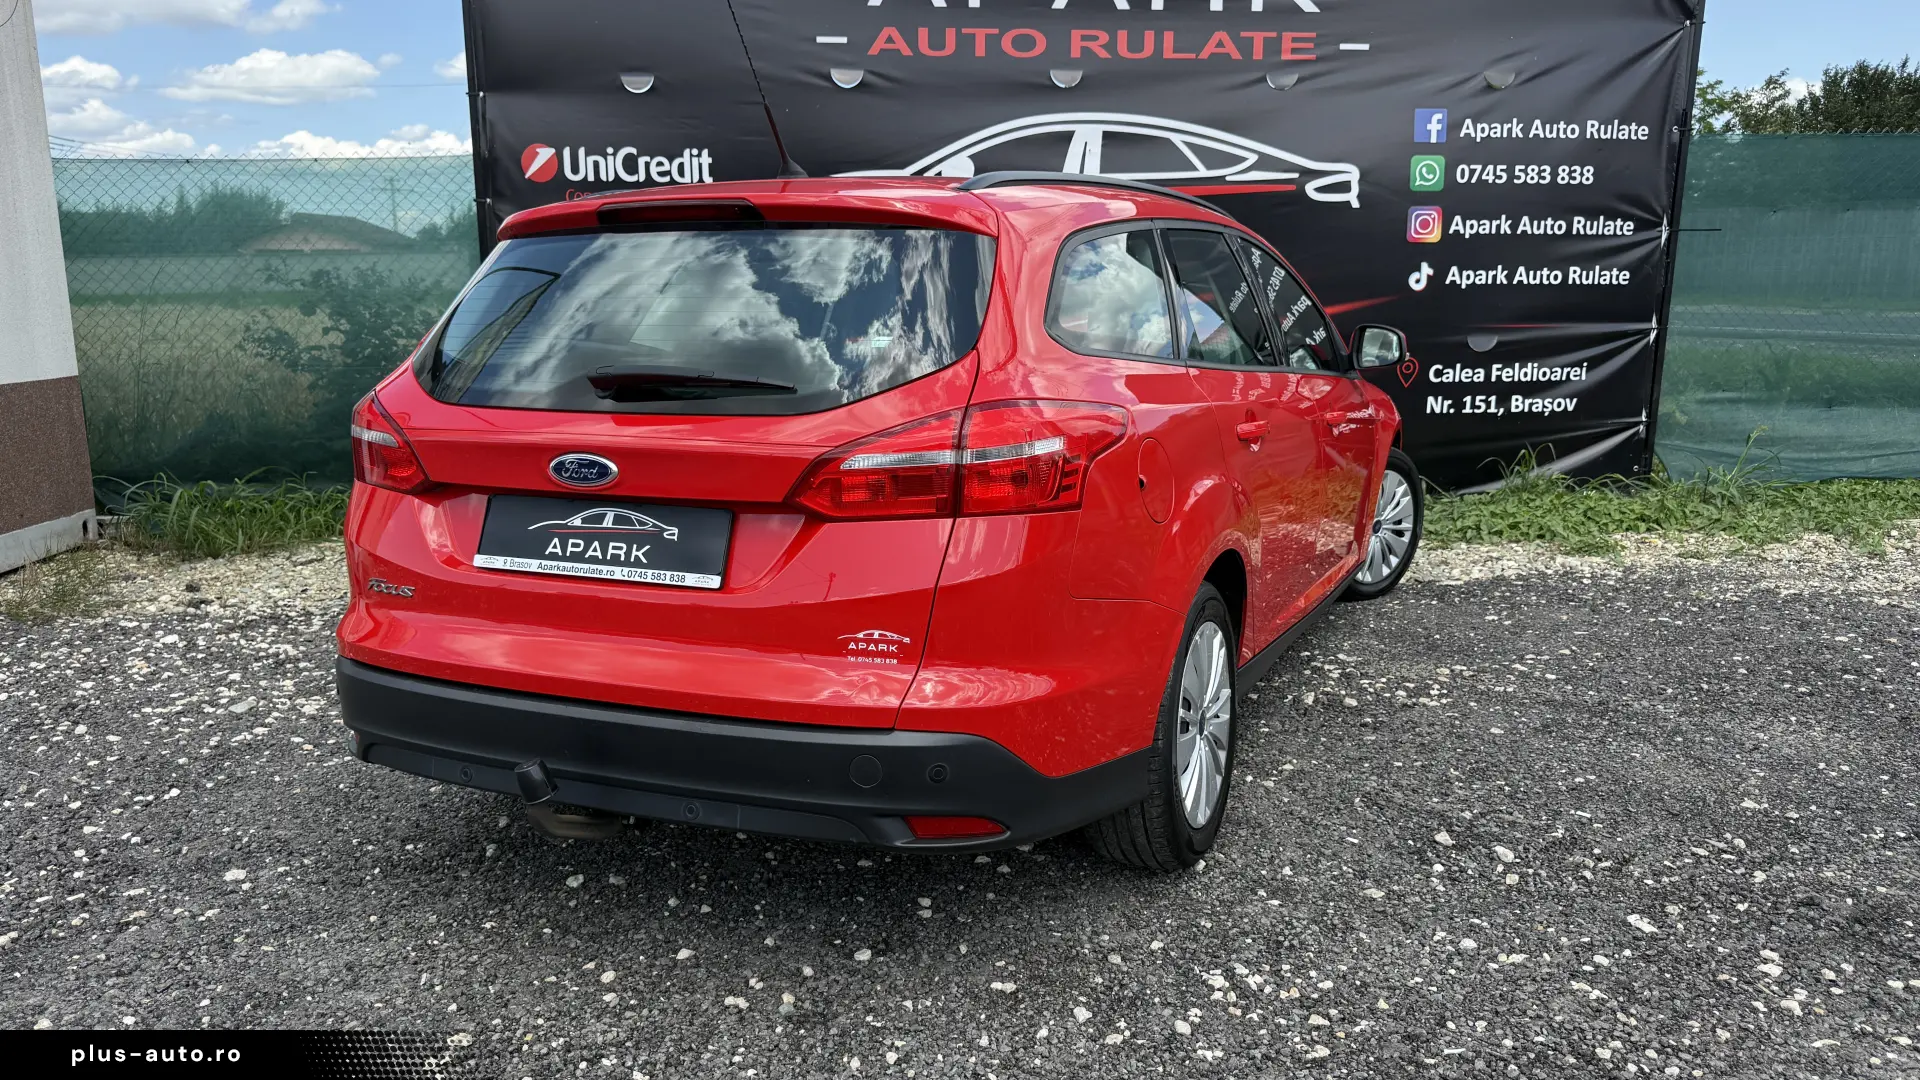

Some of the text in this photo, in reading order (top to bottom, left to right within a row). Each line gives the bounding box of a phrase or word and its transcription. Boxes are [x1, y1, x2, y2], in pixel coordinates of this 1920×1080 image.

[867, 26, 1317, 61] AUTO RULATE
[1460, 118, 1649, 142] Apark Auto Rulate
[563, 146, 714, 184] UniCredit
[1456, 164, 1595, 185] 0745 583 838
[1449, 215, 1635, 236] Apark Auto Rulate
[1445, 265, 1630, 289] Apark Auto Rulate
[1428, 362, 1588, 383] Calea Feldioarei
[1426, 395, 1577, 417] Nr. 151, Brașov
[561, 459, 599, 479] Ford
[544, 537, 651, 564] APARK
[509, 559, 533, 570] Brasov
[537, 562, 616, 577] Aparkautorulate.ro
[627, 569, 649, 580] 0745
[650, 571, 667, 582] 583
[669, 574, 686, 583] 838
[848, 641, 899, 653] APARK
